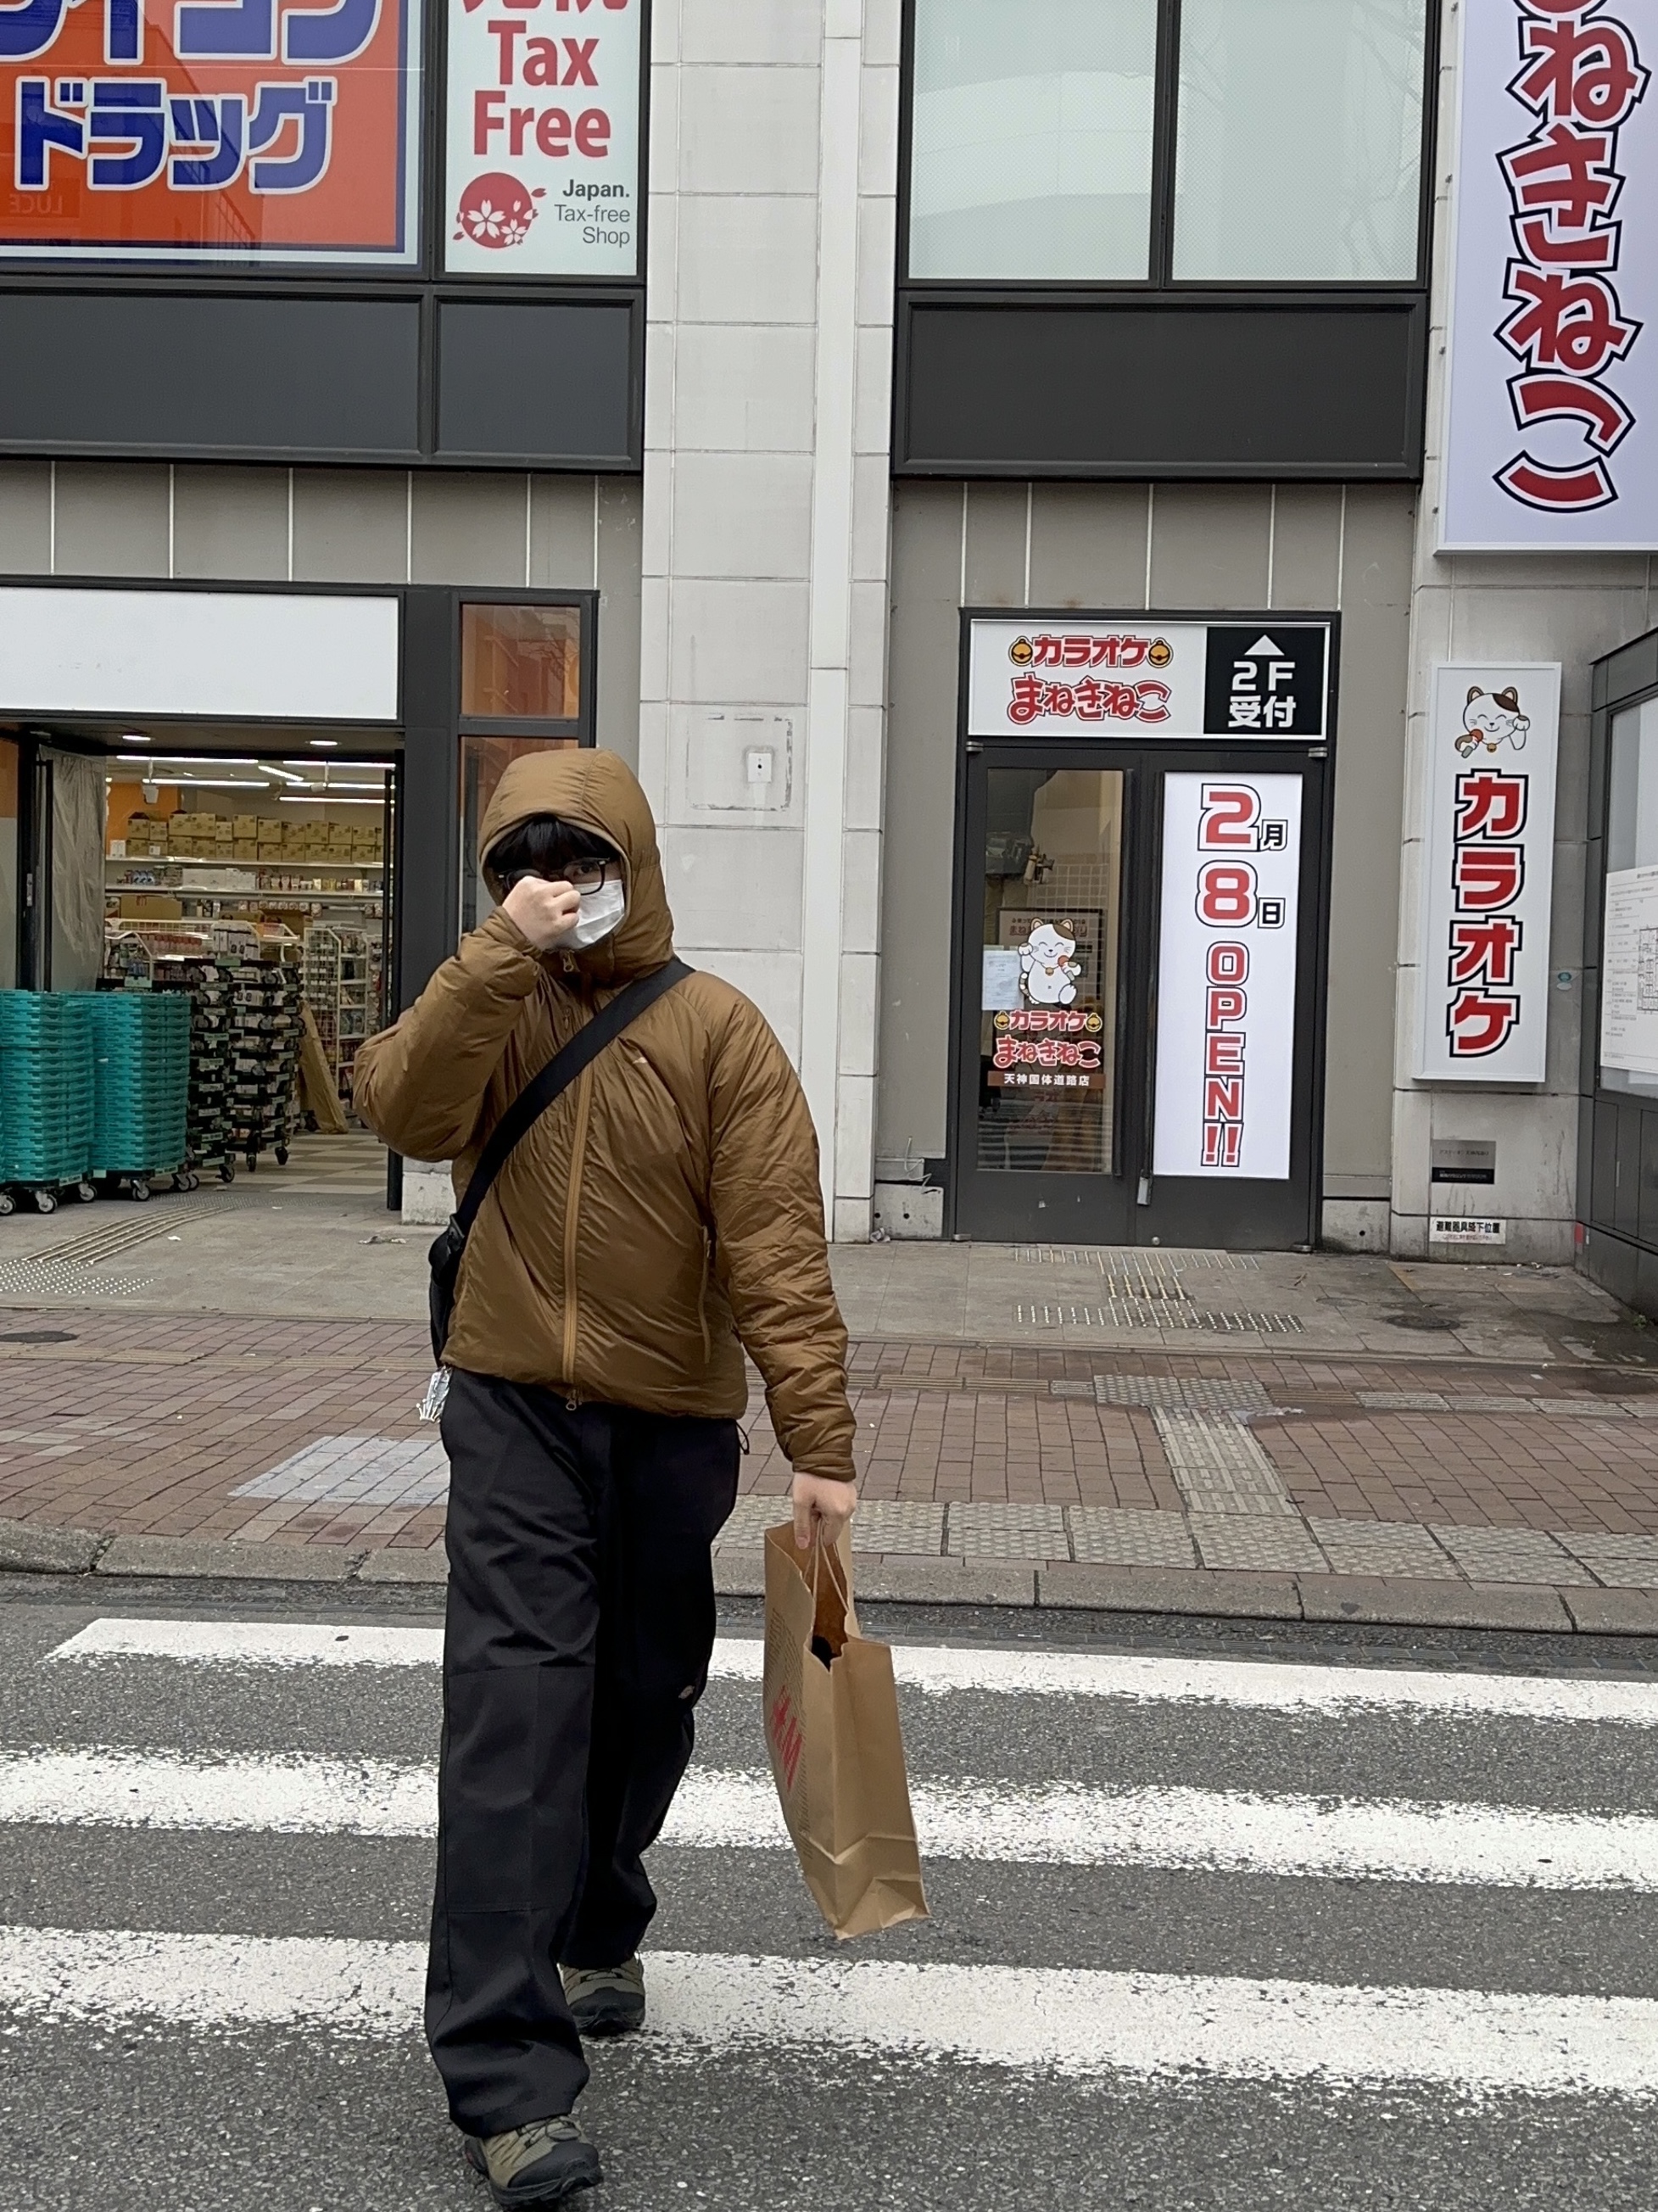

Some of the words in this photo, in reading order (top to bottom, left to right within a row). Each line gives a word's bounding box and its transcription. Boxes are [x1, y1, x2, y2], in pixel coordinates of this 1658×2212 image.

[488, 20, 600, 87] Tax
[16, 76, 337, 193] ドラッグ
[473, 91, 611, 158] Free
[562, 178, 630, 202] Japan.
[554, 204, 631, 223] Tax-free
[582, 226, 631, 249] Shop
[1492, 0, 1651, 513] ねきねこ
[1029, 634, 1150, 668] カラオケ
[1231, 661, 1296, 691] 2F
[1007, 672, 1171, 725] まねきねこ
[1228, 695, 1296, 729] 受付
[1197, 783, 1287, 852] 2月
[1194, 859, 1286, 930] 8日
[1447, 768, 1529, 1059] カラオケ
[1008, 1009, 1088, 1032] カラオケ
[993, 1034, 1102, 1069] まねきねこ
[1200, 941, 1250, 1167] OPEN!!
[1003, 1073, 1091, 1086] 天神国体道路店
